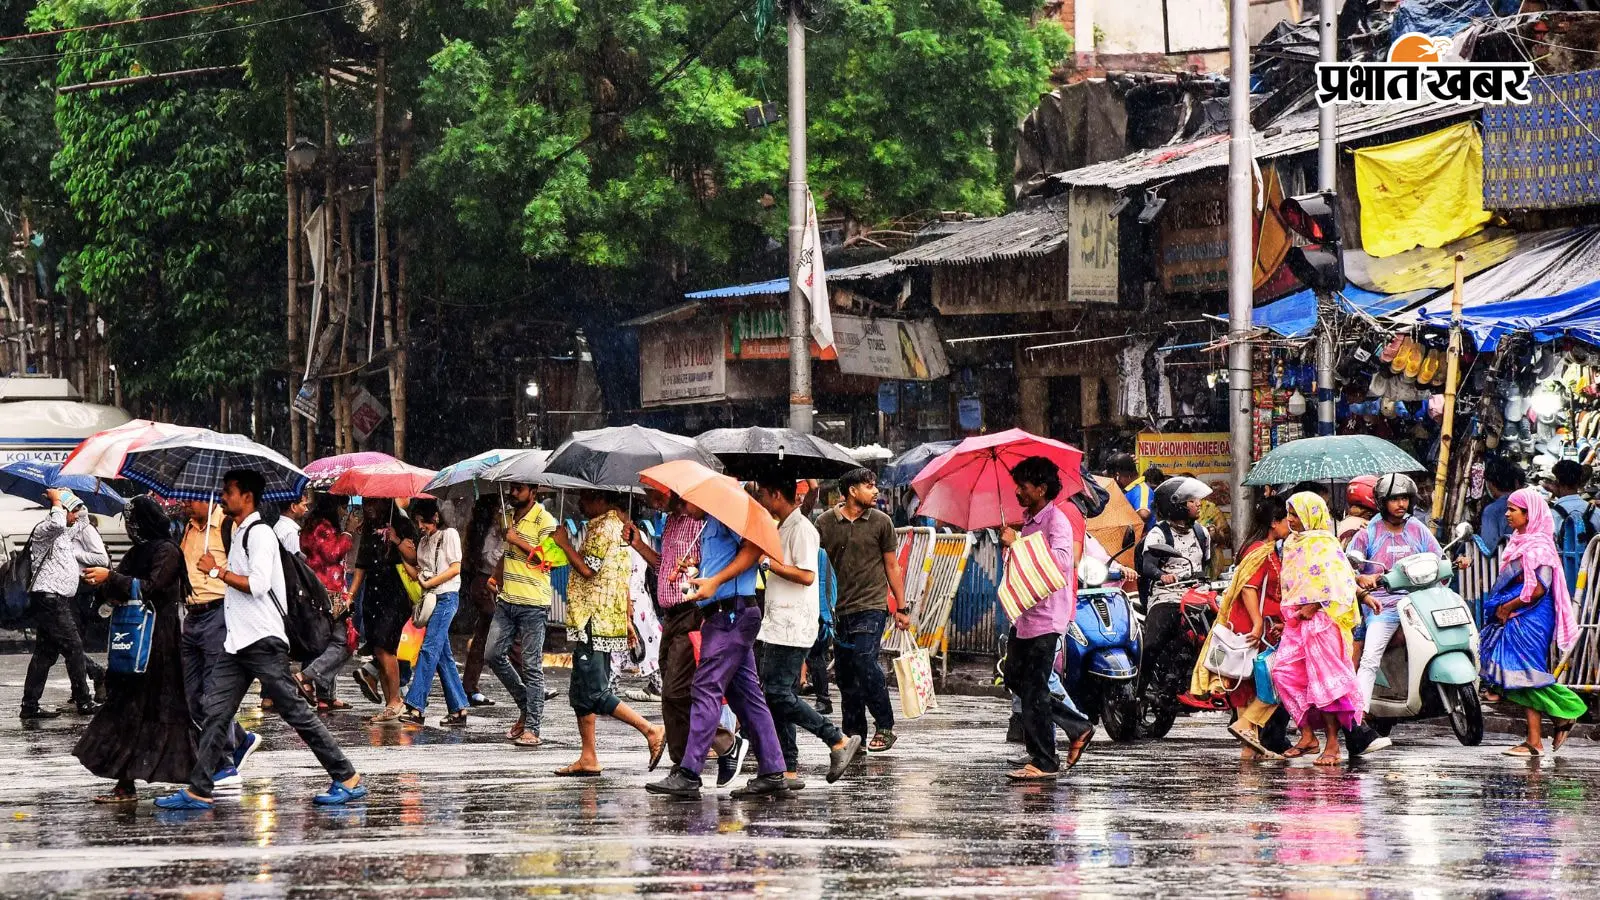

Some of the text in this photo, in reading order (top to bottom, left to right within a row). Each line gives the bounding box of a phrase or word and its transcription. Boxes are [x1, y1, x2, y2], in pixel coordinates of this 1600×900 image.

[1138, 441, 1157, 455] NEW
[1158, 441, 1218, 455] CHOWRINGHEE
[6, 452, 69, 462] KOLKATA
